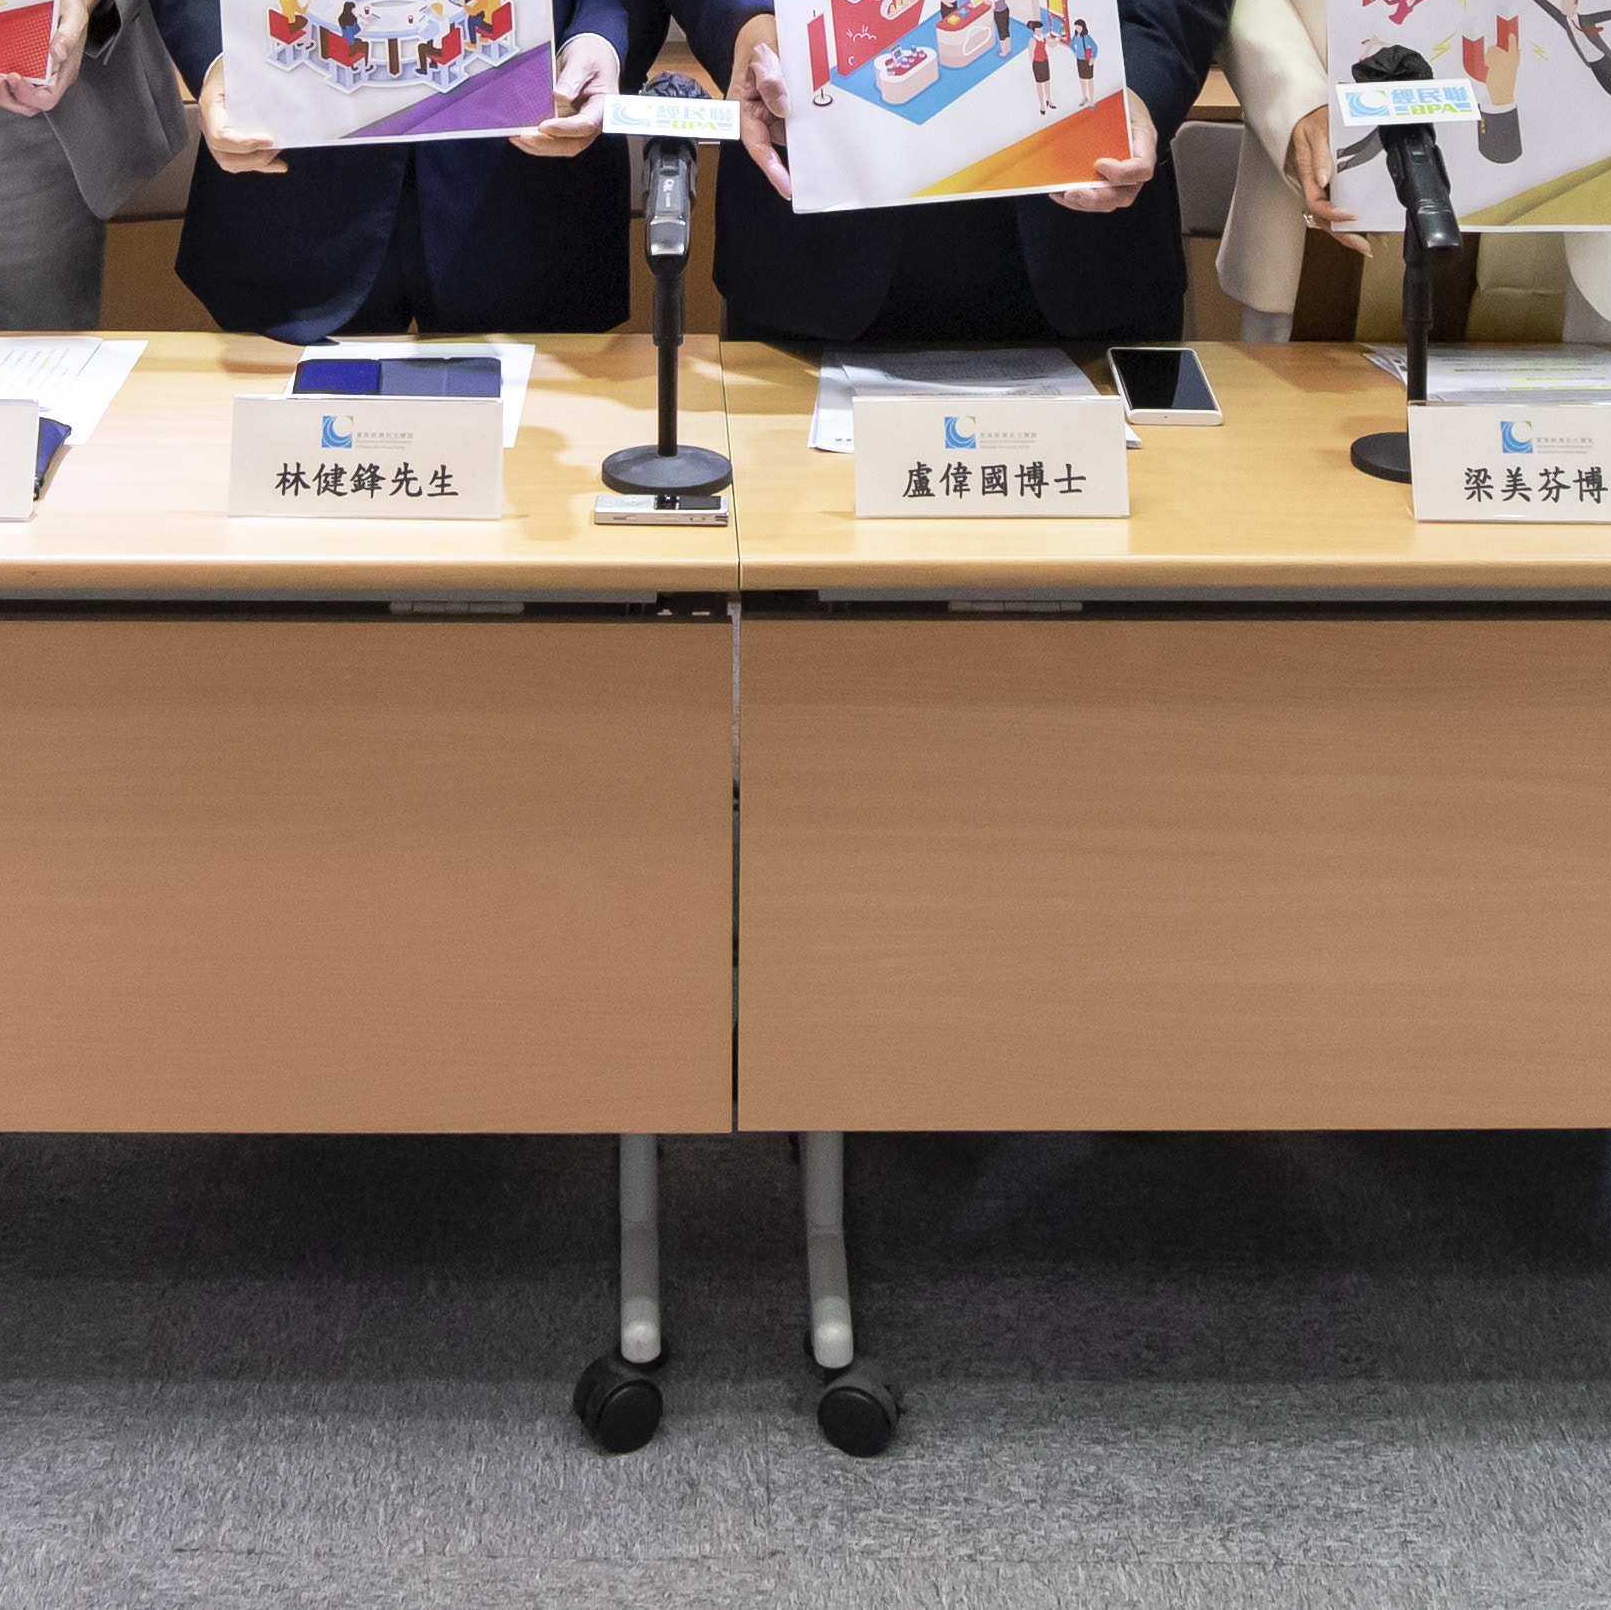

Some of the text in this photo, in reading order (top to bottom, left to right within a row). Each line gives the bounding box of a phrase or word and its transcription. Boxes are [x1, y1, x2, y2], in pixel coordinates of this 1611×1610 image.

[1391, 86, 1470, 105] 經民聯
[1410, 103, 1458, 115] BPA
[274, 461, 459, 499] 林健鋒先生
[902, 460, 1087, 499] 盧偉國博士
